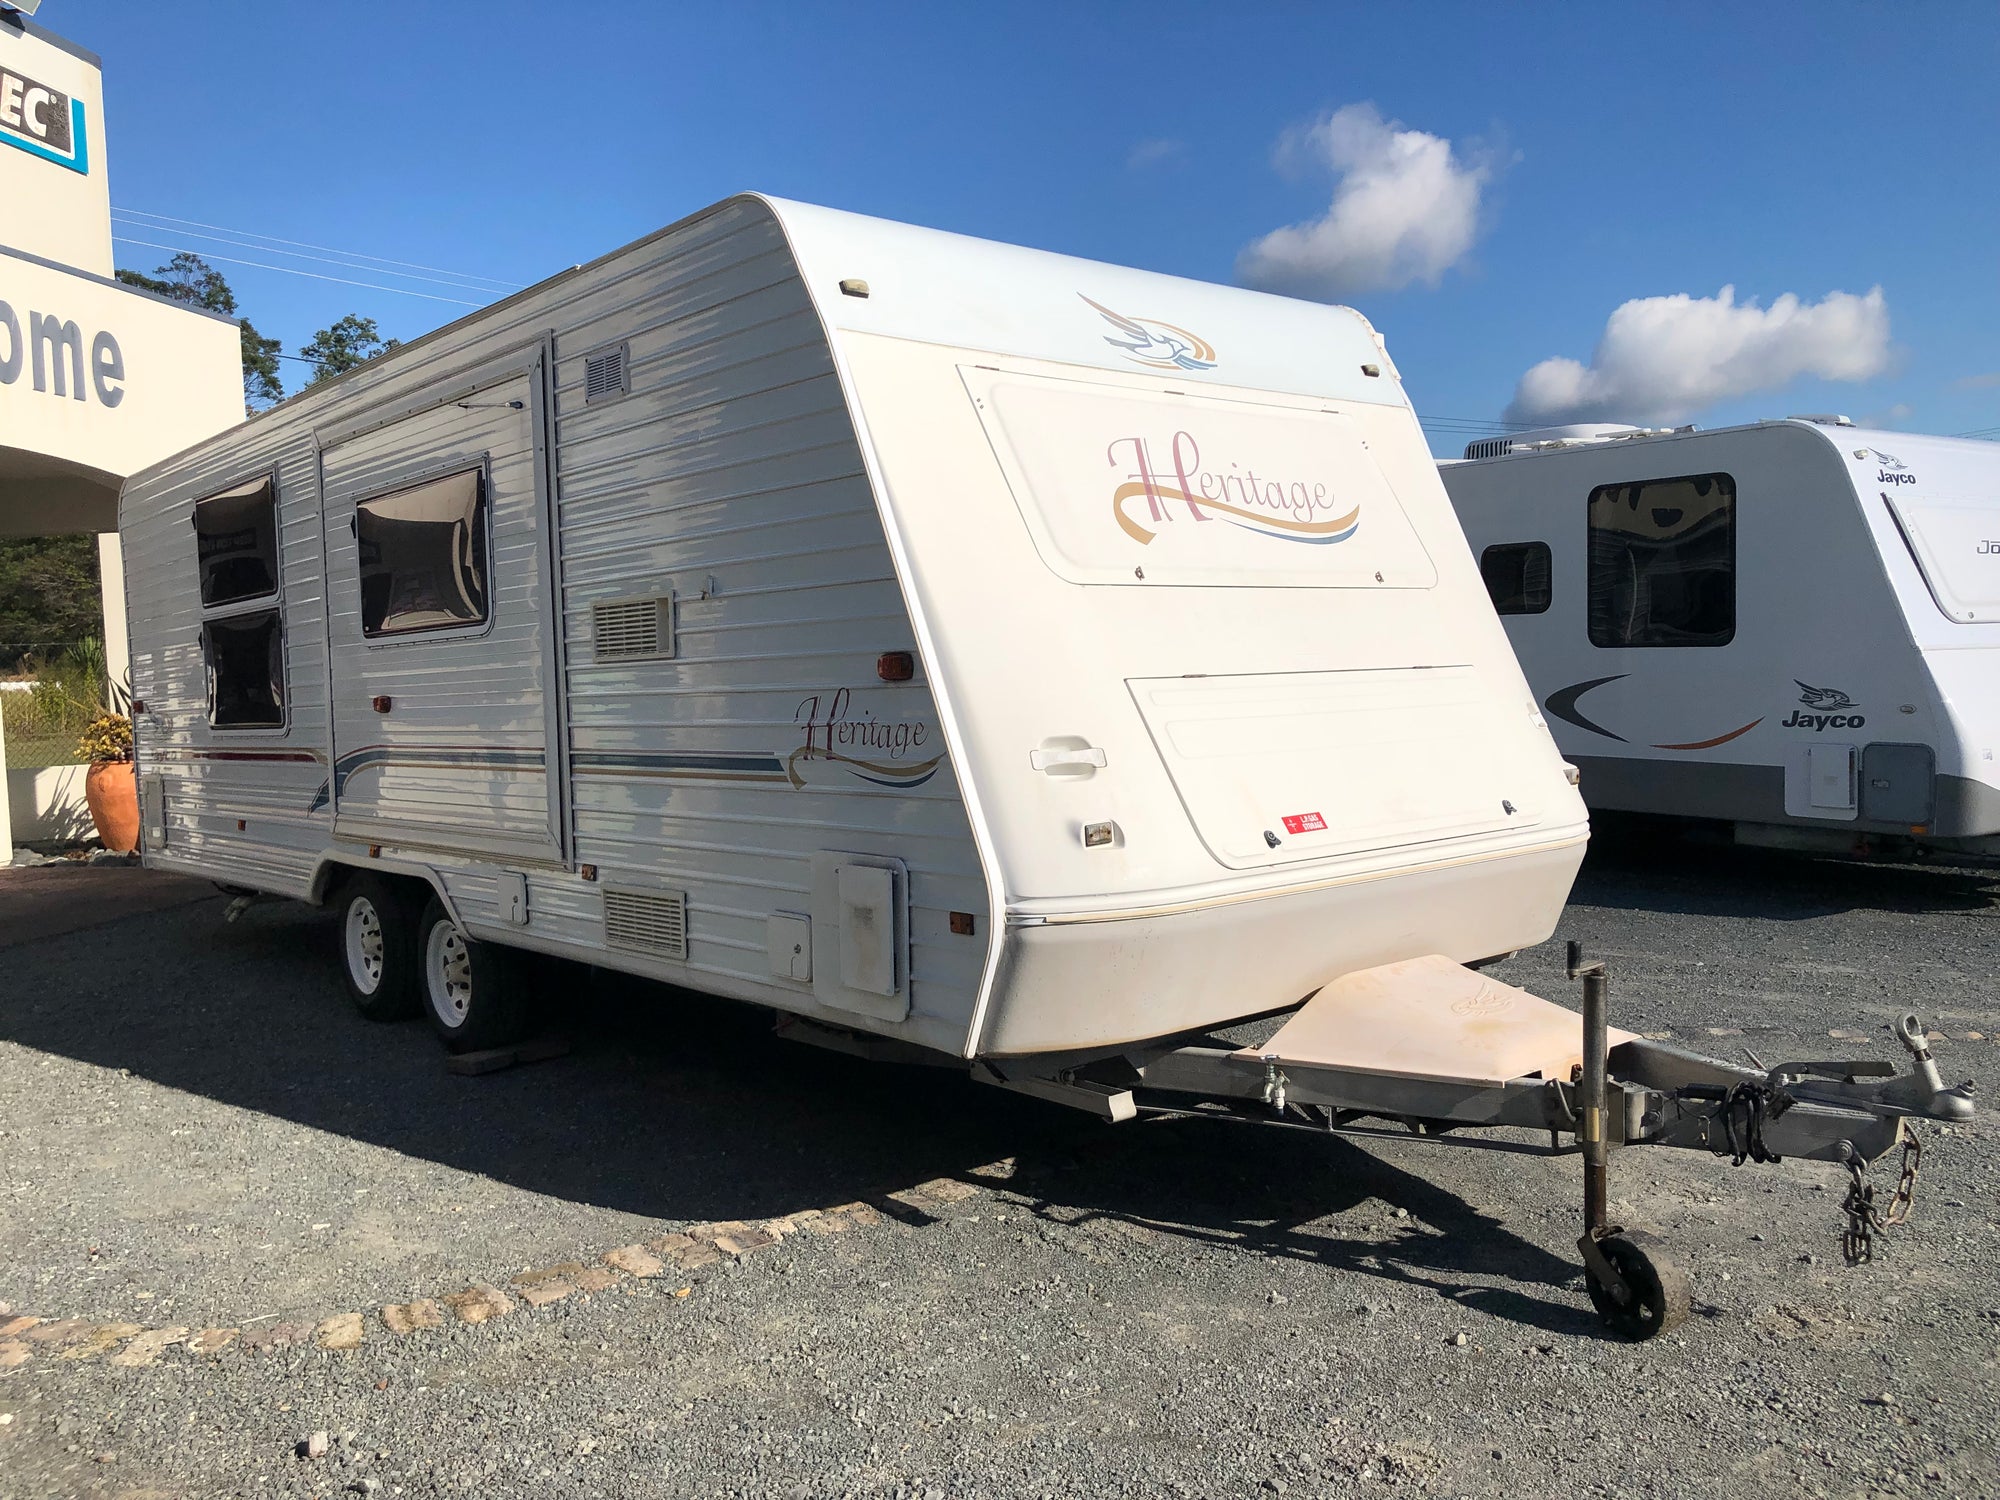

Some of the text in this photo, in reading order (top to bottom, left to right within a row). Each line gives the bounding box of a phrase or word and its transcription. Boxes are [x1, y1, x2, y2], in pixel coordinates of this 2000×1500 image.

[1107, 430, 1335, 523] Heritage
[1877, 469, 1917, 486] Jayco
[793, 687, 929, 760] Heritage
[1781, 710, 1866, 732] Jayco
